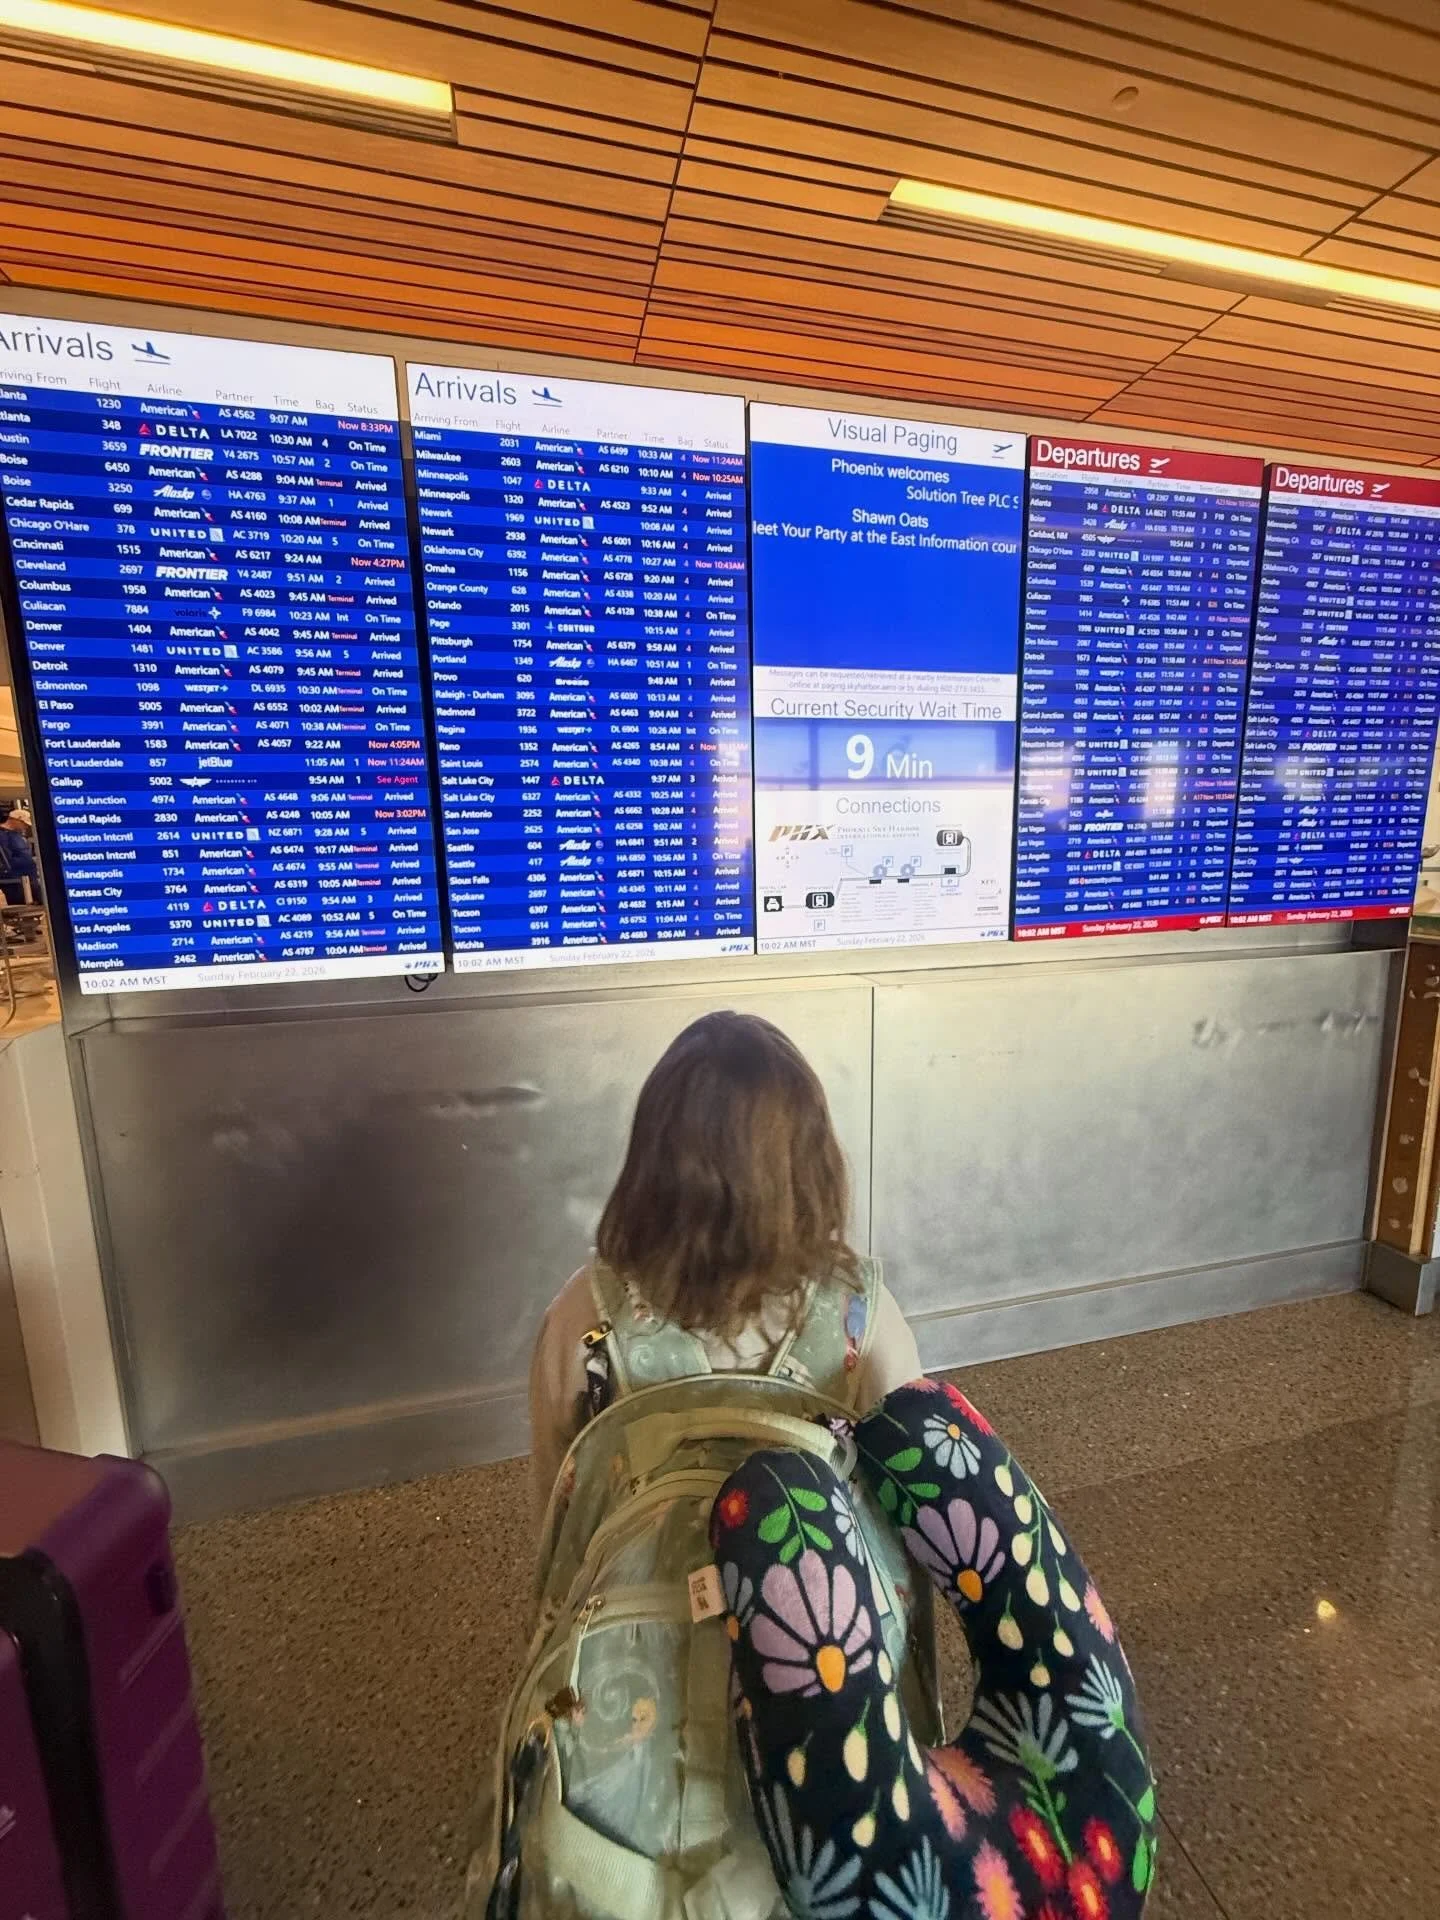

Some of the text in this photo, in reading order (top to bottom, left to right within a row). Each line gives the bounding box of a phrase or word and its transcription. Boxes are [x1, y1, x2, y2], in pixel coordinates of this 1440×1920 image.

[36, 373, 378, 414] From Flight Airline Partner Time Bag Status
[415, 372, 517, 405] Arrivals
[97, 398, 393, 433] 1230 American AS 4562 9:07 AM Now 8:33PM
[414, 413, 521, 431] Arriving From Flight
[102, 420, 386, 453] 348 DELTA LA 7022 10:30 AM 4 On Time
[415, 431, 573, 453] Miami 2031 American
[828, 418, 958, 455] Visual Paging
[102, 441, 214, 461] 3659 FRONTIER
[1037, 441, 1141, 470] Departures
[0, 455, 387, 491] Boise 6450 American 9:04 AM Arrived
[416, 451, 743, 483] Milwaukee 2603 Now 10:25AM
[831, 459, 950, 484] Phoenix welcomes
[3, 476, 195, 500] Boise 3250 Alaska
[418, 469, 731, 501] Minneapolis 1047 DELTA Arrived
[1276, 467, 1364, 495] Departures
[906, 486, 957, 503] Solution
[960, 491, 985, 506] Tree
[988, 493, 1010, 509] PLC
[6, 497, 133, 514] Cedar Rapids 699
[1111, 505, 1141, 515] DELTA
[421, 508, 580, 527] Newark UNITED
[852, 509, 929, 529] Shawn Oats
[9, 518, 207, 539] Chicago O'Hare 378 UNITED
[1336, 527, 1361, 536] DELTA
[782, 522, 812, 538] Your
[815, 525, 848, 544] Party
[851, 531, 863, 543] at
[867, 530, 887, 544] the
[891, 531, 916, 547] East
[919, 535, 988, 551] Information
[13, 539, 64, 550] Cincinnati
[424, 545, 484, 558] Oklahoma City
[1099, 552, 1129, 560] UNITED
[1324, 554, 1351, 563] UNITED
[17, 560, 228, 581] Cleveland 2697 FRONTIER
[1101, 566, 1127, 575] American
[19, 581, 71, 591] Columbus
[427, 583, 488, 595] Orange County
[23, 601, 66, 611] Culiacan
[26, 621, 62, 631] Denver
[430, 619, 450, 628] Page
[33, 661, 68, 671] Detroit
[36, 682, 88, 691] Edmonton
[39, 701, 74, 710] El Paso
[771, 698, 1002, 720] Current Security Wait Time
[42, 721, 70, 730] Fargo
[48, 757, 233, 769] Fort Lauderdale 857 jetBlue
[846, 734, 933, 780] 9 Min
[51, 776, 418, 788] Gallup See Agent
[442, 776, 605, 786] Salt Lake City 1447 DELTA
[55, 796, 127, 806] Grand Junction
[836, 797, 941, 815] Connections
[61, 834, 101, 843] Houston
[768, 825, 834, 842] PHX
[66, 870, 123, 881] Indianapolis
[69, 887, 122, 898] Kansas City
[72, 903, 190, 916] Los Angeles 4119
[760, 942, 782, 950] 10:02
[800, 940, 817, 948] MST
[81, 958, 124, 969] Memphis
[458, 960, 482, 968] 10:02
[505, 957, 525, 965] MST
[85, 979, 115, 989] 10:02
[120, 978, 138, 987] AM
[143, 976, 167, 985] MST
[199, 973, 235, 983] Sunday
